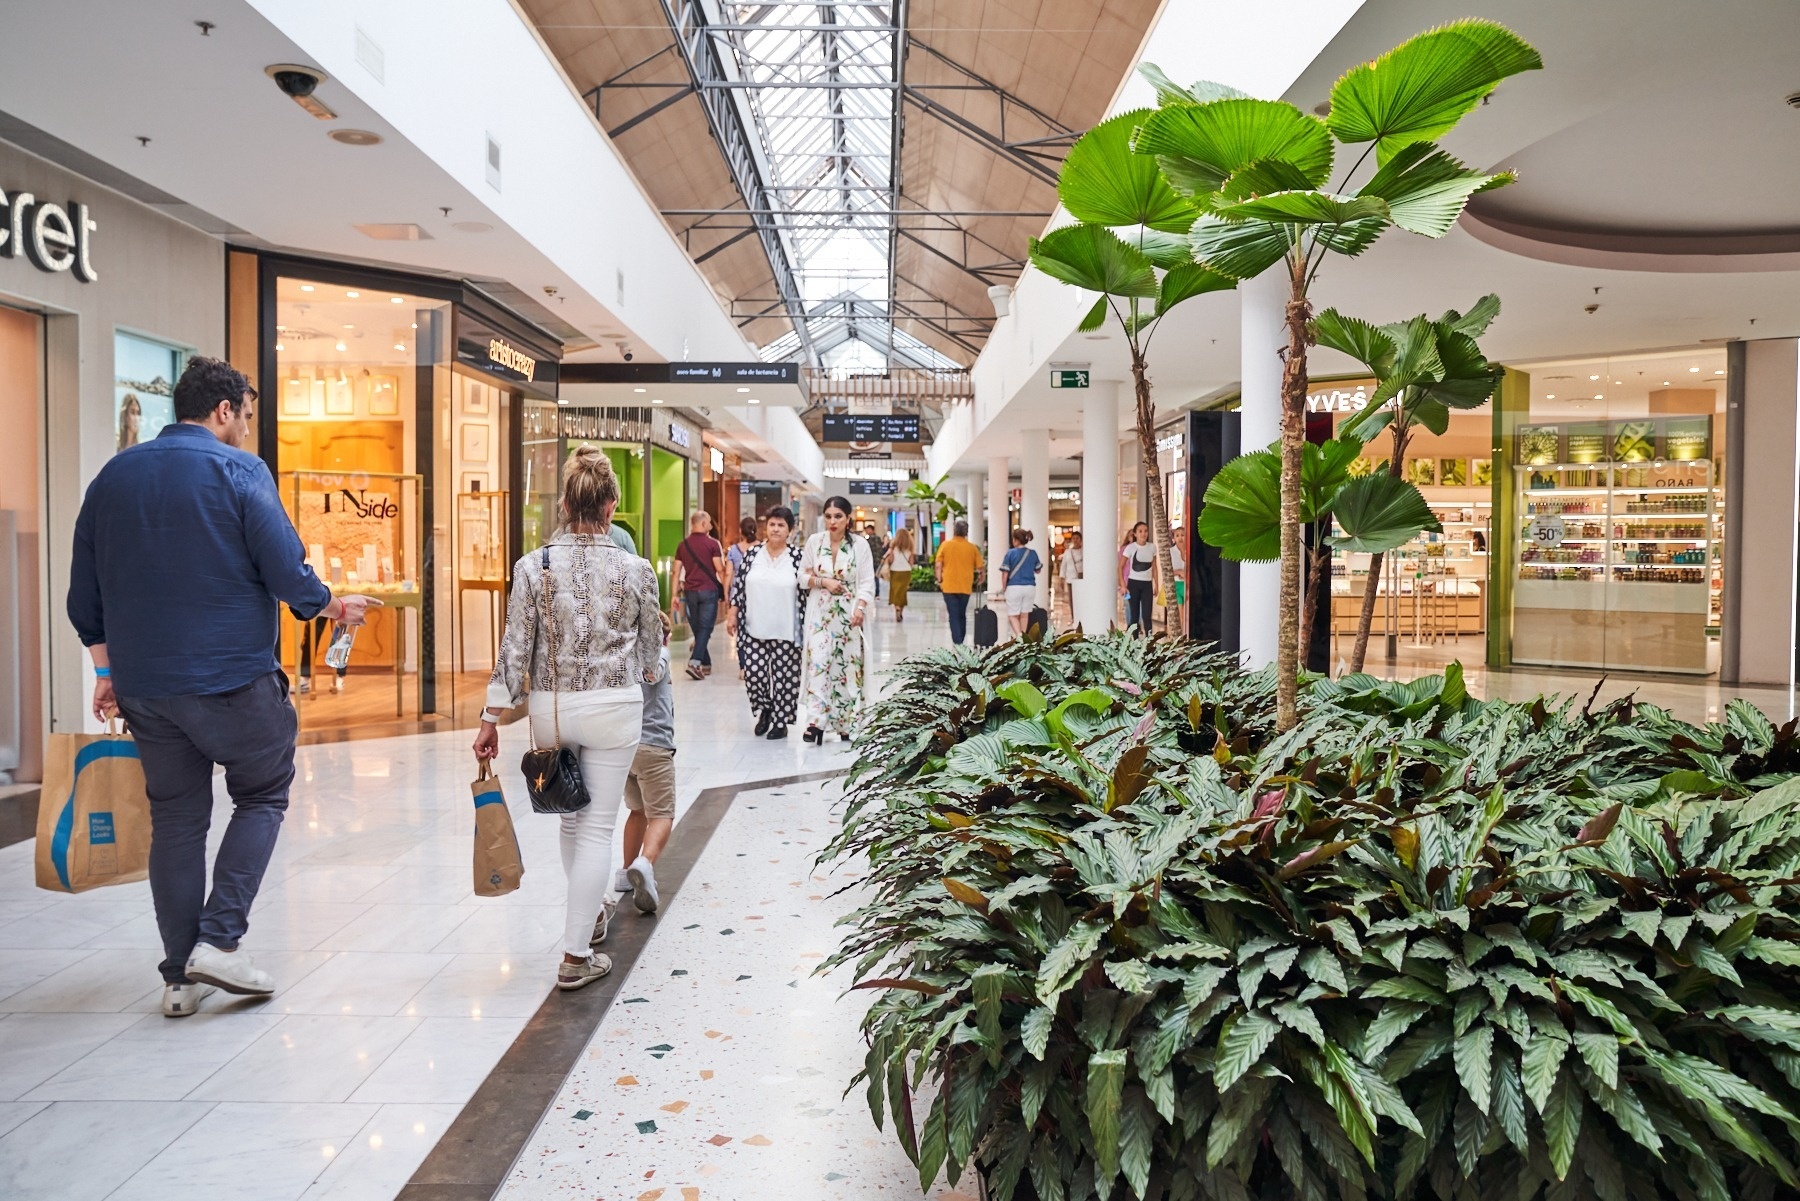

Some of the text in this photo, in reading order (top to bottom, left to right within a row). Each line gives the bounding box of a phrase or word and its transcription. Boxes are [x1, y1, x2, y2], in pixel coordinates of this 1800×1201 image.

[489, 339, 536, 383] aristocrazy
[689, 368, 709, 376] familiar
[748, 368, 755, 376] de
[1667, 436, 1705, 446] vegetales
[1533, 528, 1563, 541] -50%
